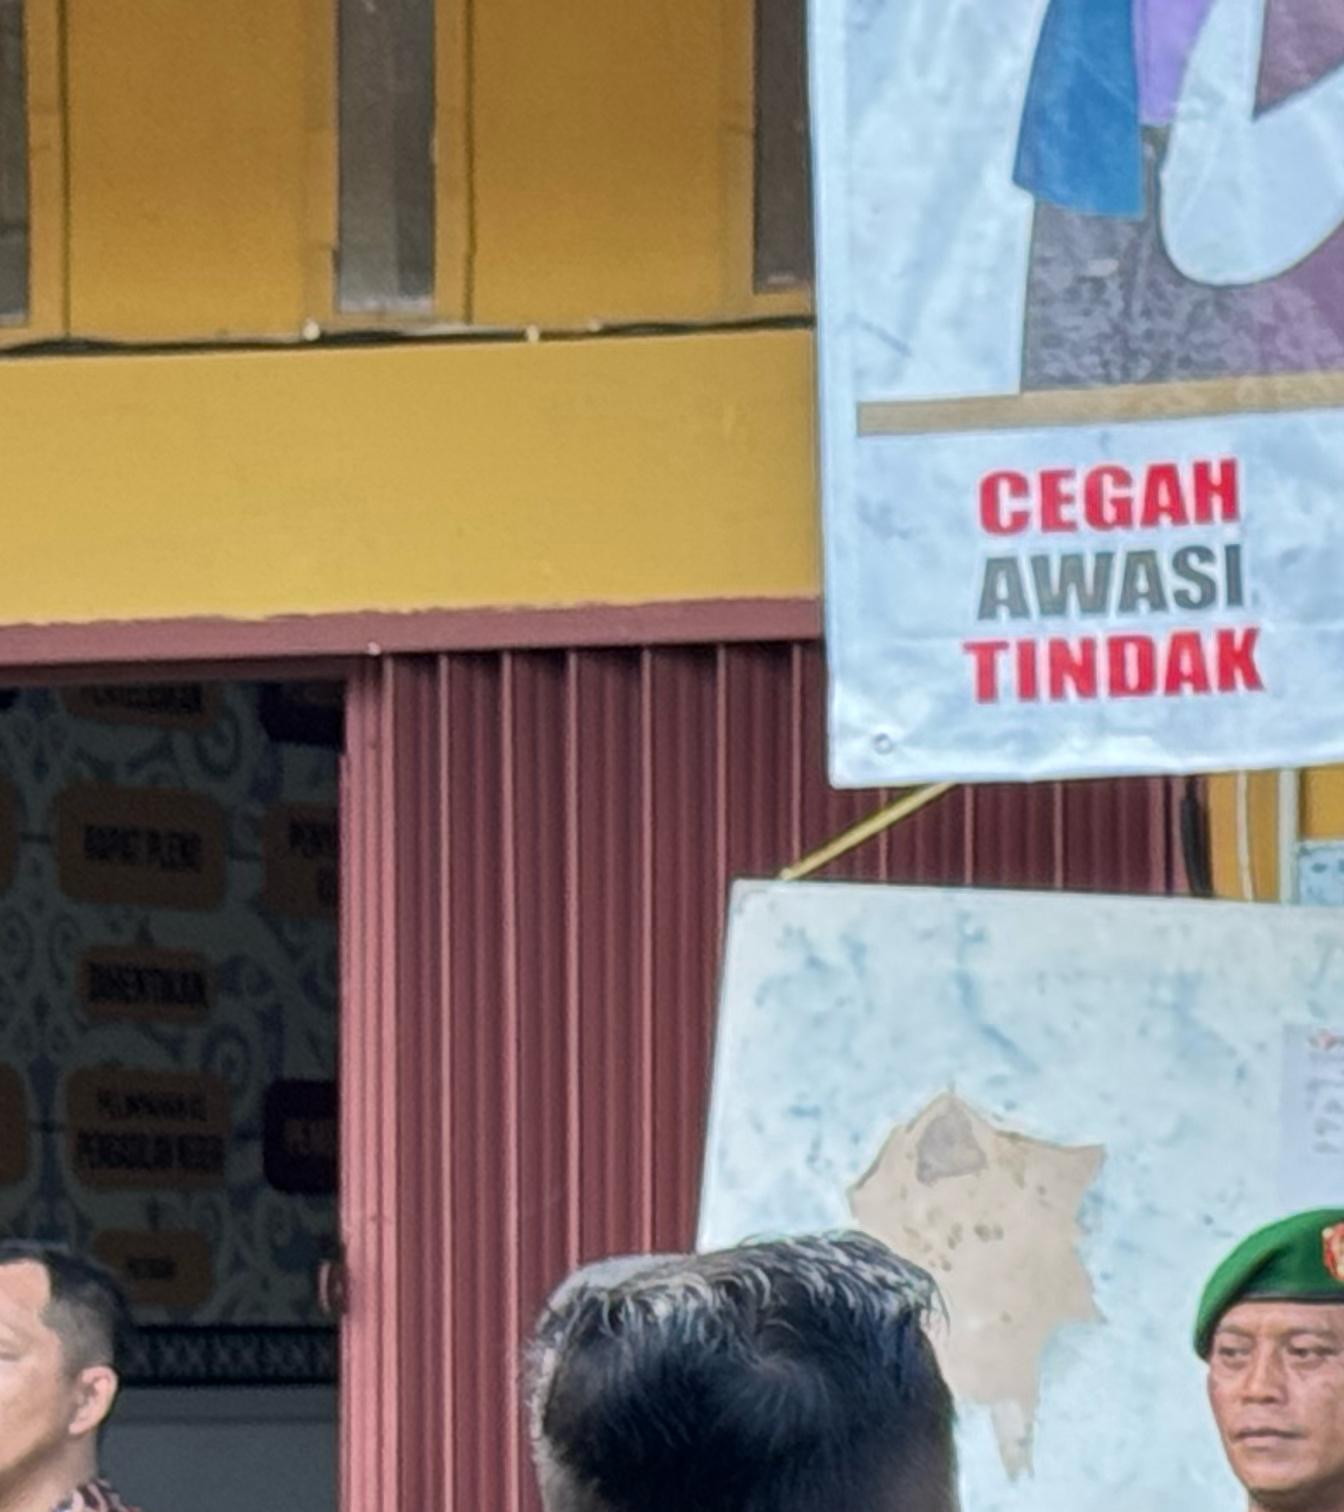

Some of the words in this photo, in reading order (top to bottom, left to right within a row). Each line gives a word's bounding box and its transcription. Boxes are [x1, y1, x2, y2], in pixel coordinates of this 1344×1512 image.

[978, 458, 1241, 535] CEGAH
[976, 543, 1245, 621] AWASI
[963, 628, 1264, 703] TINDAK
